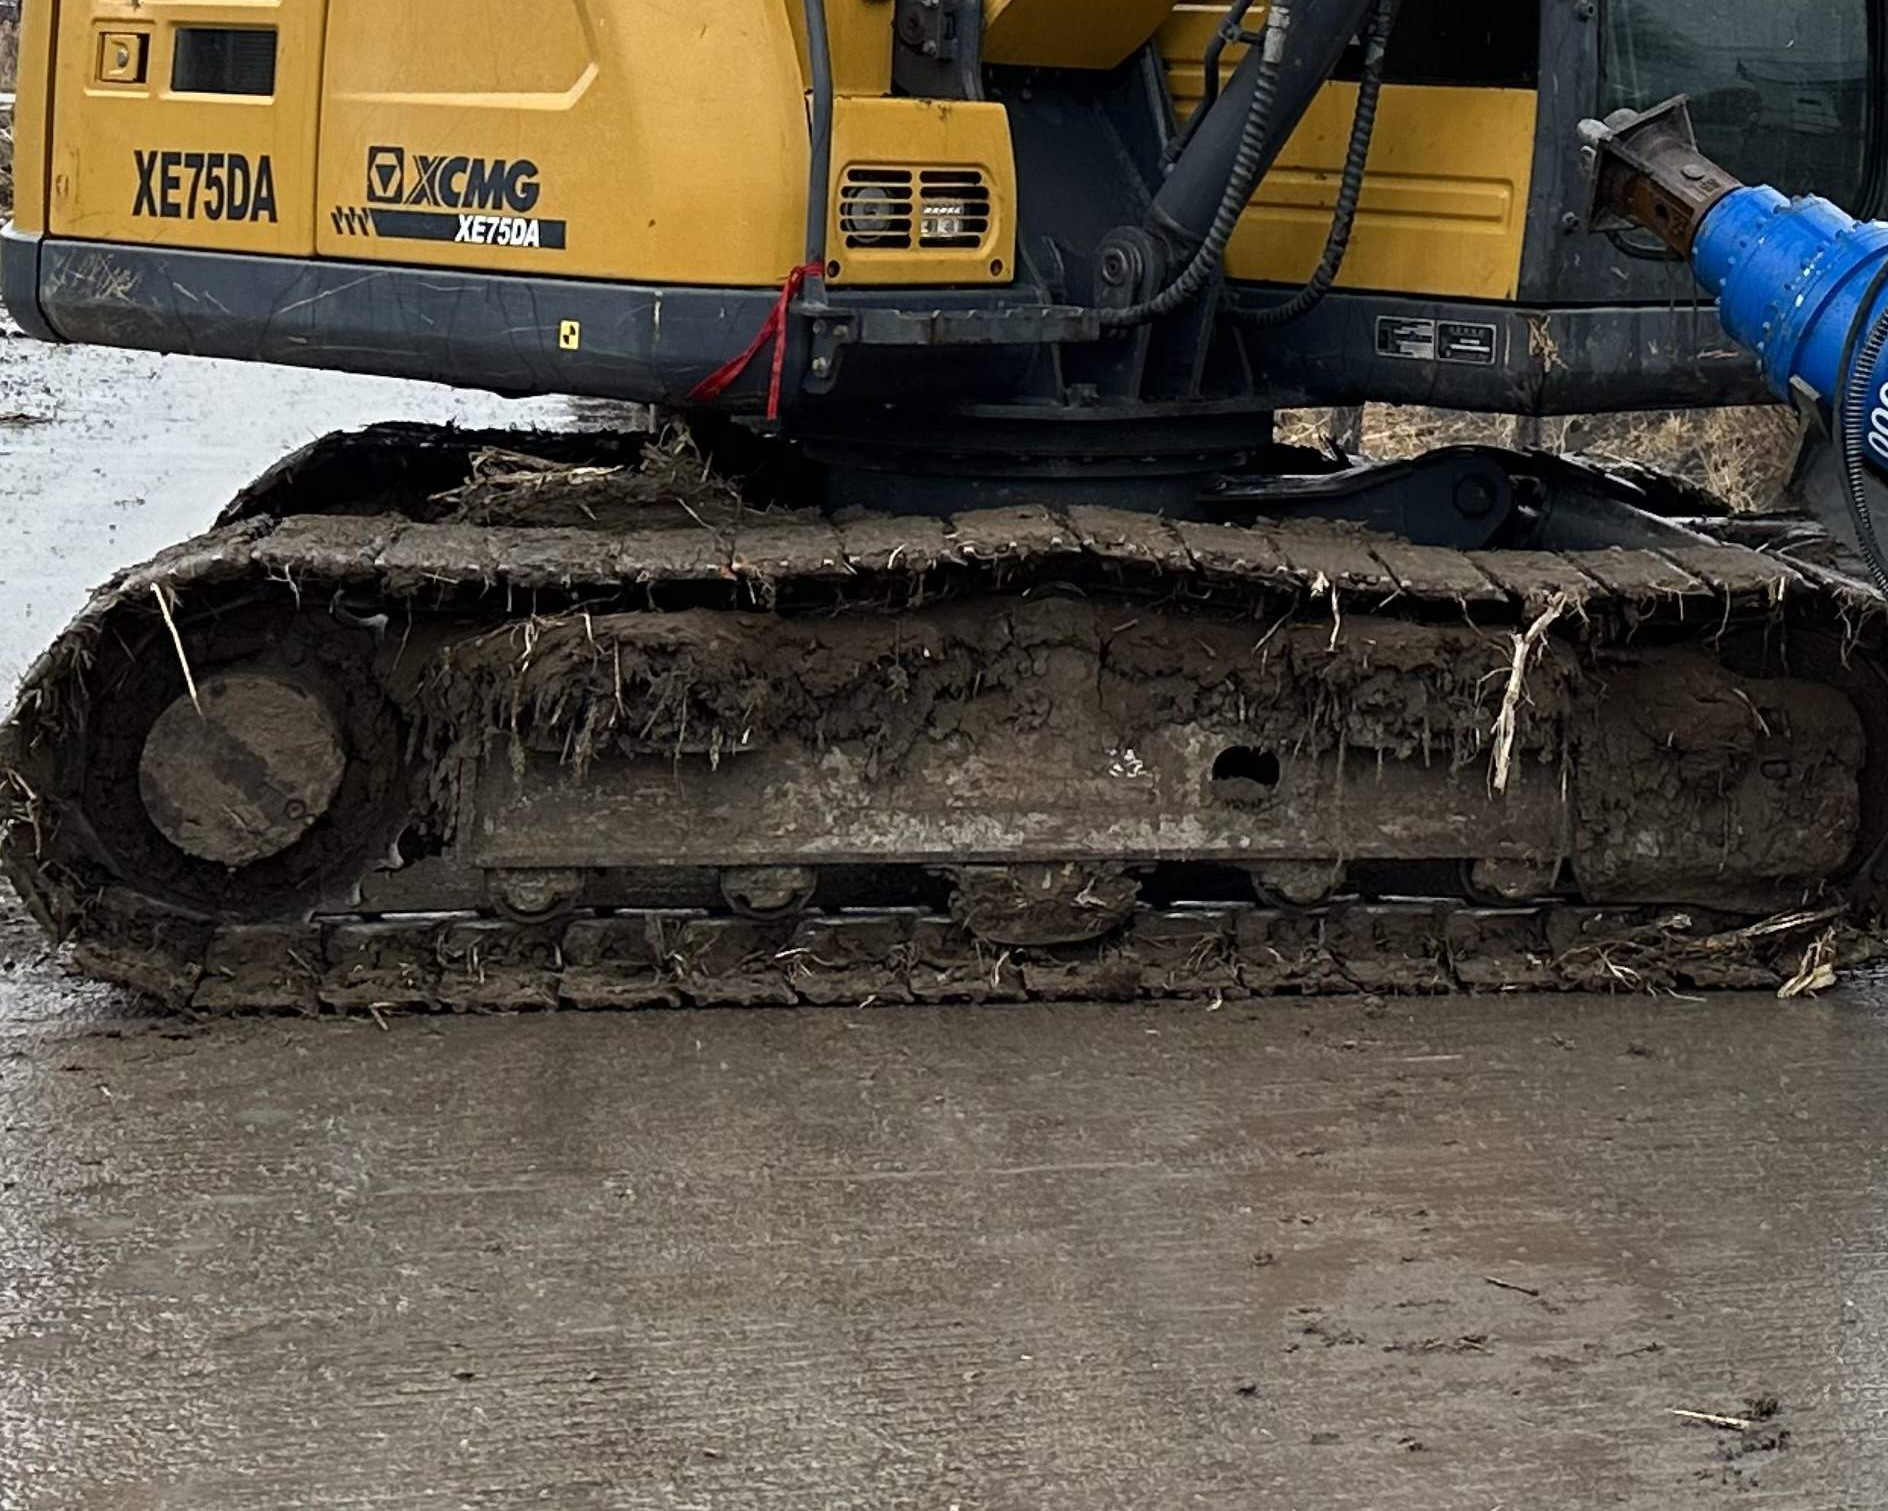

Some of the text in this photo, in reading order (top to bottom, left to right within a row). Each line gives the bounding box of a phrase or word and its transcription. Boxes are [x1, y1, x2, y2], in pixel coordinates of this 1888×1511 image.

[132, 149, 278, 223] XE75DA
[404, 155, 541, 212] XCMG
[454, 213, 541, 248] XE75DA
